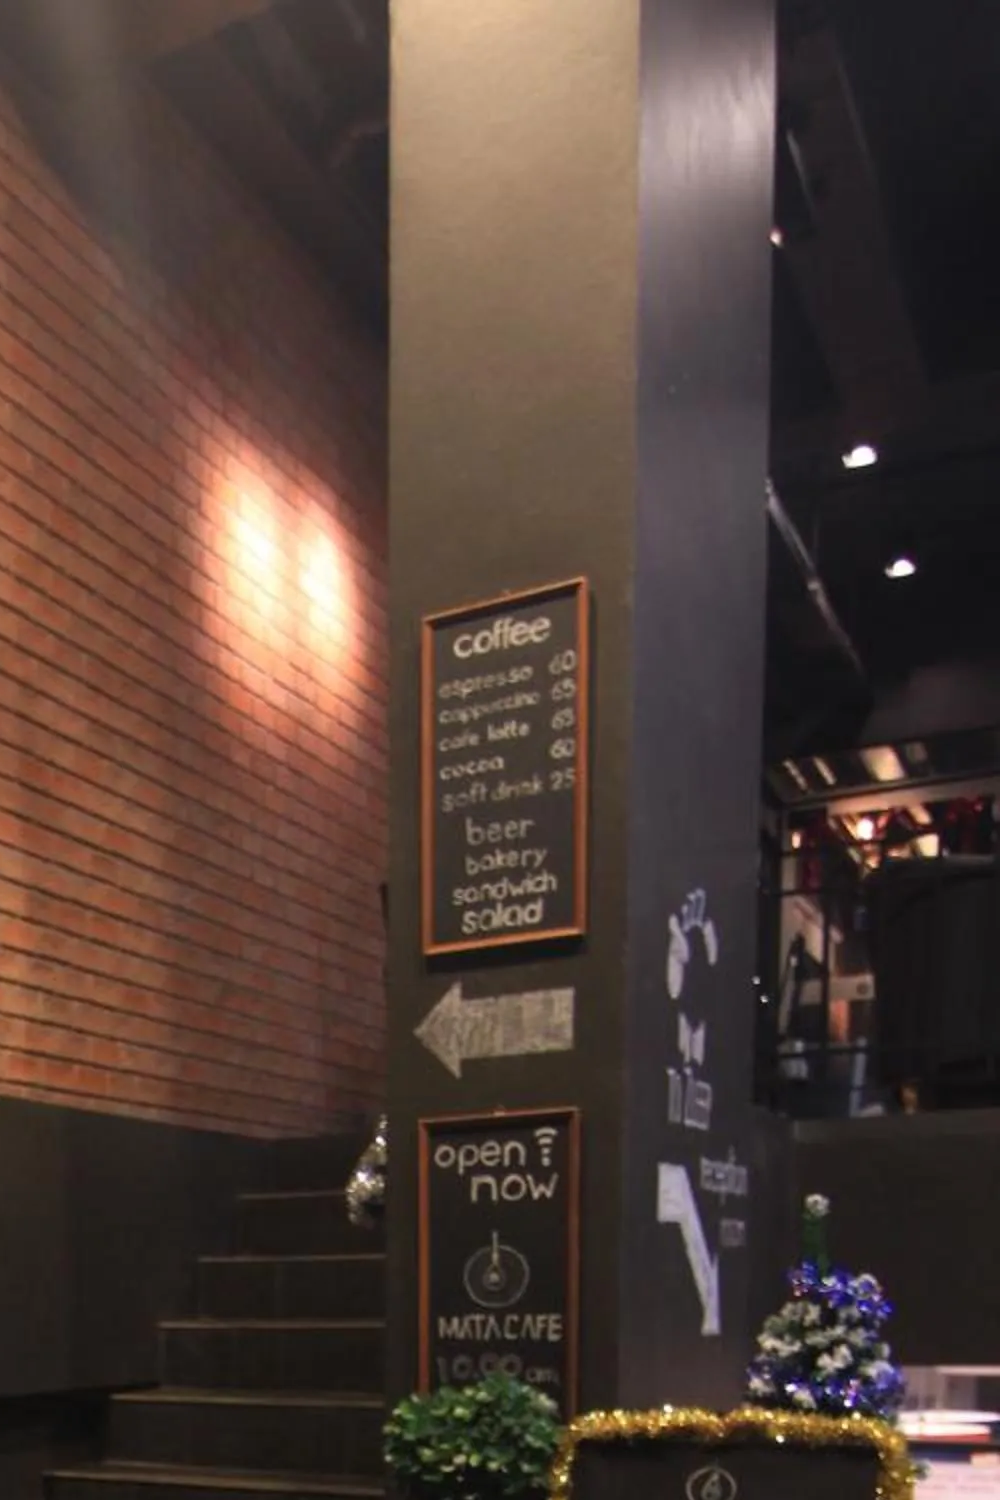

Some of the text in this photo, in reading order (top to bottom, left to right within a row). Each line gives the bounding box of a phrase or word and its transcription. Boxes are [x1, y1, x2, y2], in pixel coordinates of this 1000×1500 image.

[453, 616, 551, 659] coffee
[438, 650, 577, 700] espresso 60
[439, 756, 505, 781] cocoa
[441, 767, 577, 813] soft drink 25
[465, 816, 535, 846] beer
[465, 846, 548, 876] bakery
[453, 869, 557, 906] sandwich
[461, 900, 543, 935] salad
[434, 1140, 527, 1174] open
[470, 1172, 559, 1204] now
